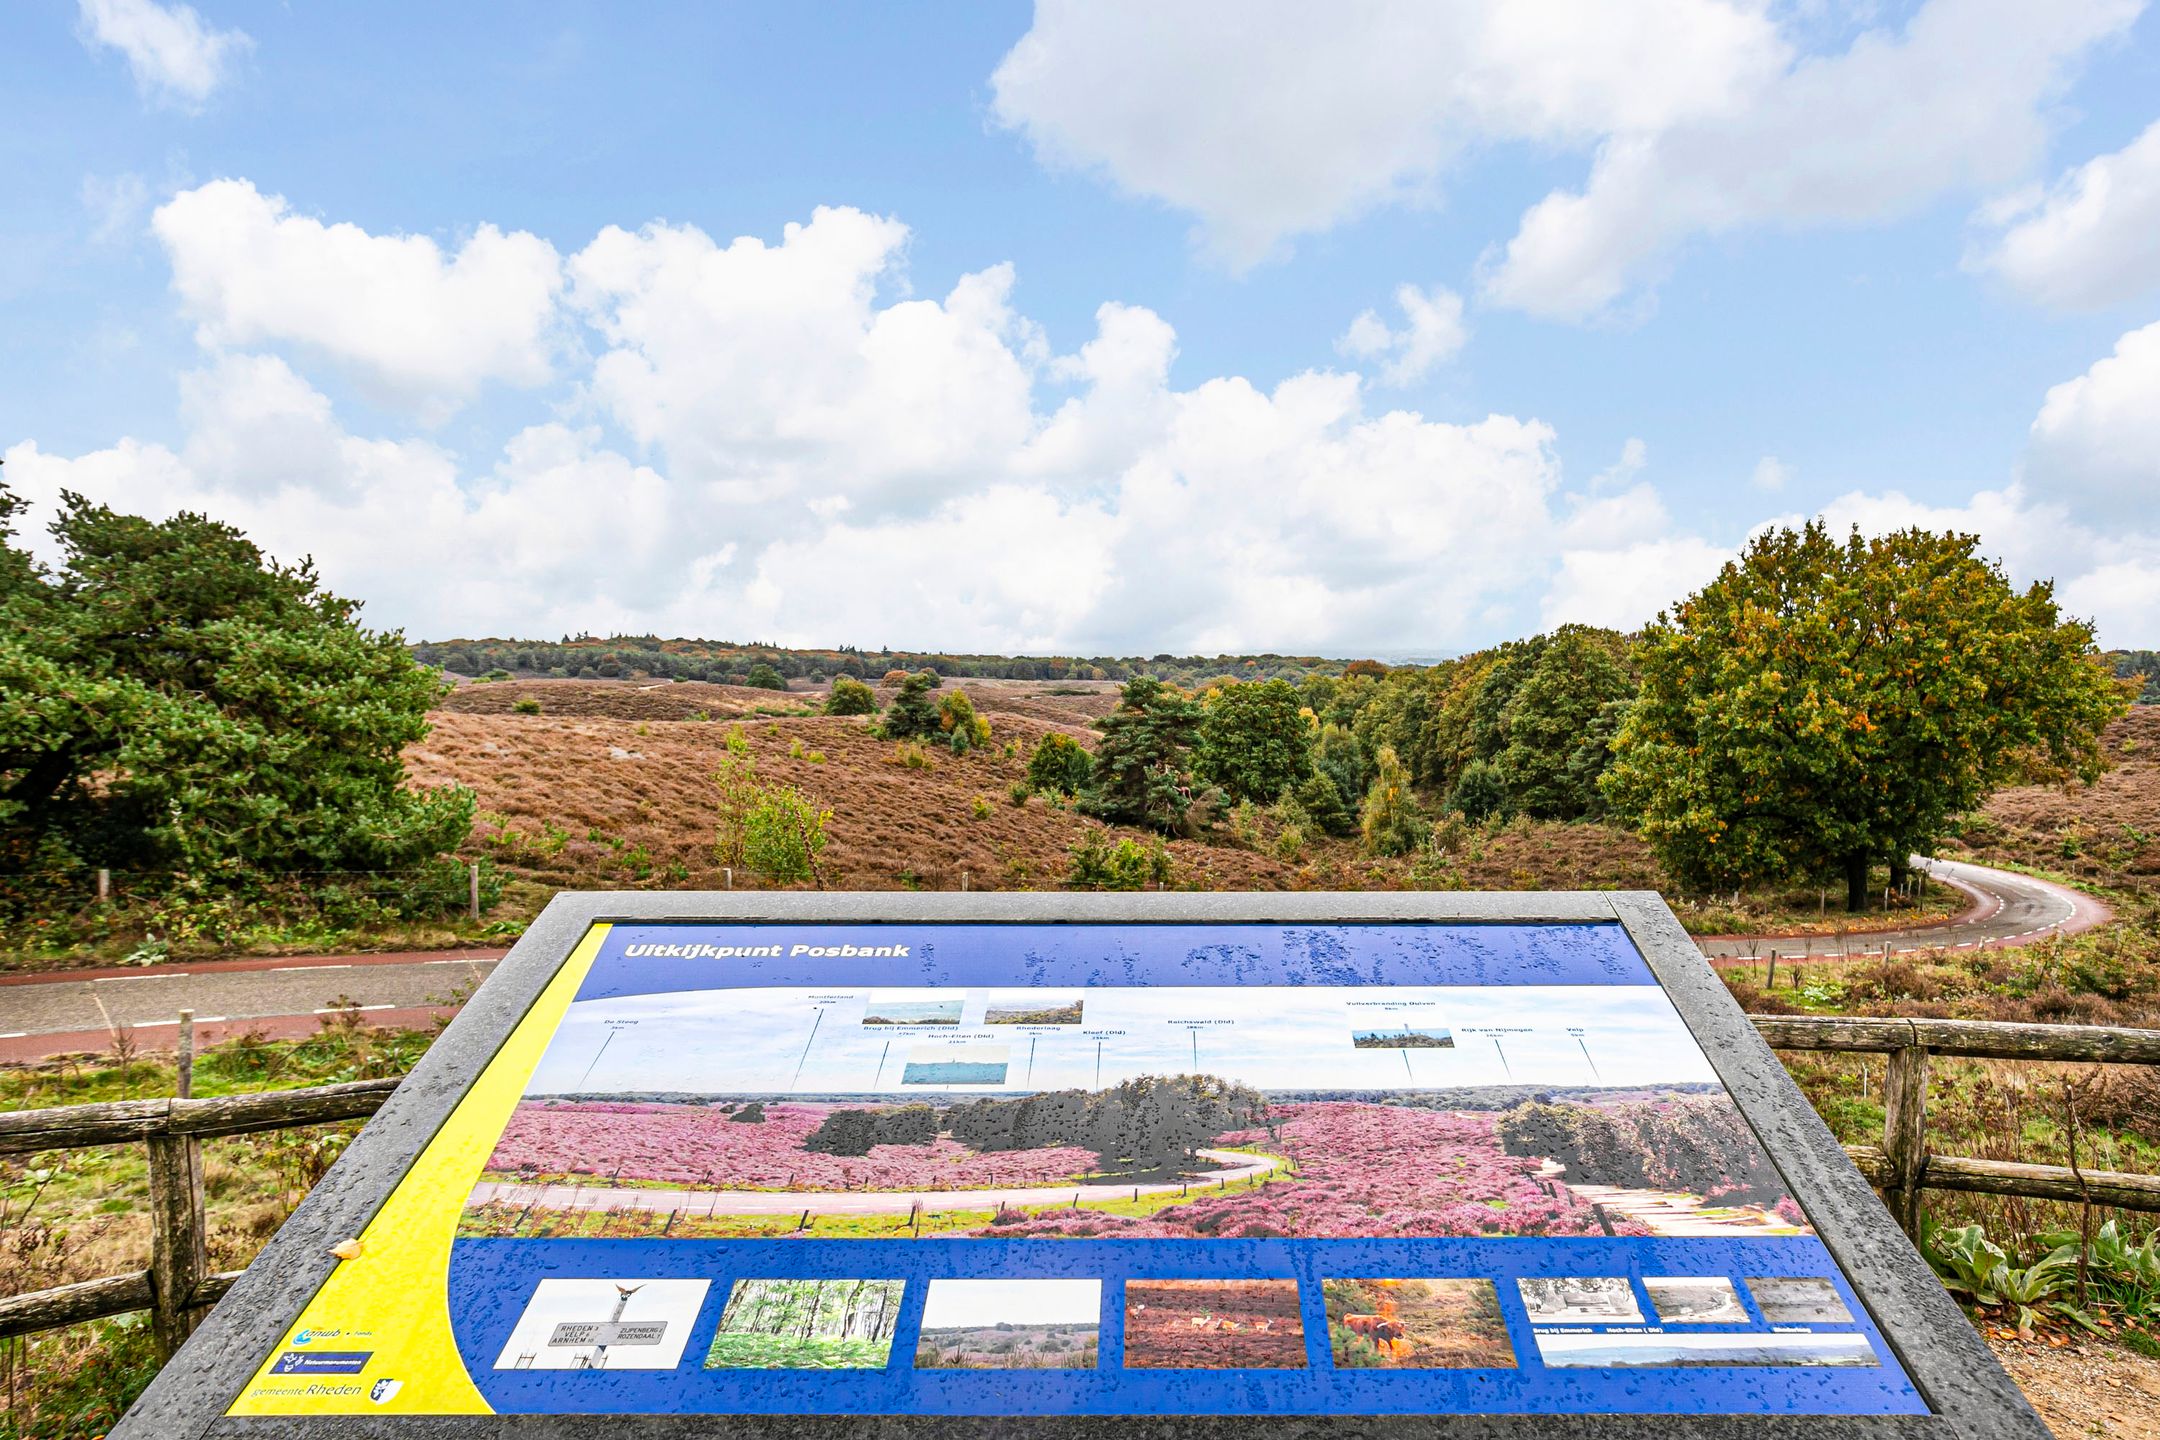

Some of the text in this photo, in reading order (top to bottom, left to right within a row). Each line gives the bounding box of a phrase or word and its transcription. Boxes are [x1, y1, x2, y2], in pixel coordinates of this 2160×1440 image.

[624, 944, 911, 960] Uitkijkpunt Posbank
[305, 1329, 341, 1337] anwb
[251, 1383, 362, 1397] gemeente Rheden
